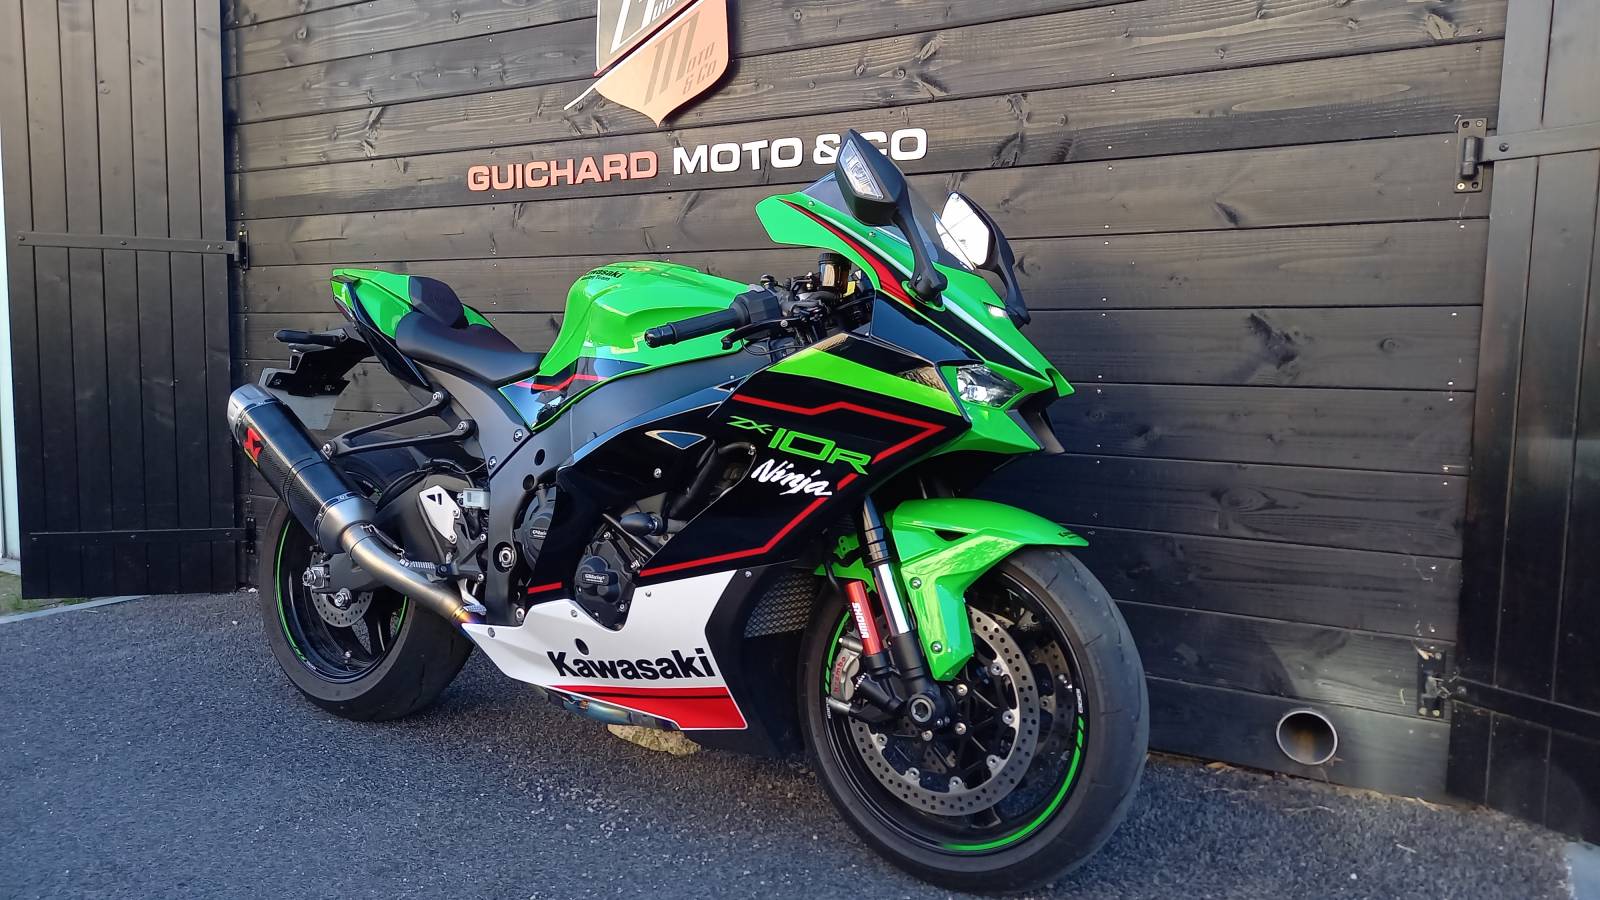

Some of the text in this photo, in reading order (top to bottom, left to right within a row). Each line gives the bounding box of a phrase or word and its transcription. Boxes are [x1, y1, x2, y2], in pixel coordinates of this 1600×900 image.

[467, 151, 657, 191] GUICHARD
[673, 138, 802, 175] MOTO
[813, 133, 841, 165] &
[727, 415, 872, 476] ZX-10R
[750, 458, 833, 496] Ninja
[852, 602, 870, 639] SHOWA
[547, 647, 716, 680] Kawasaki
